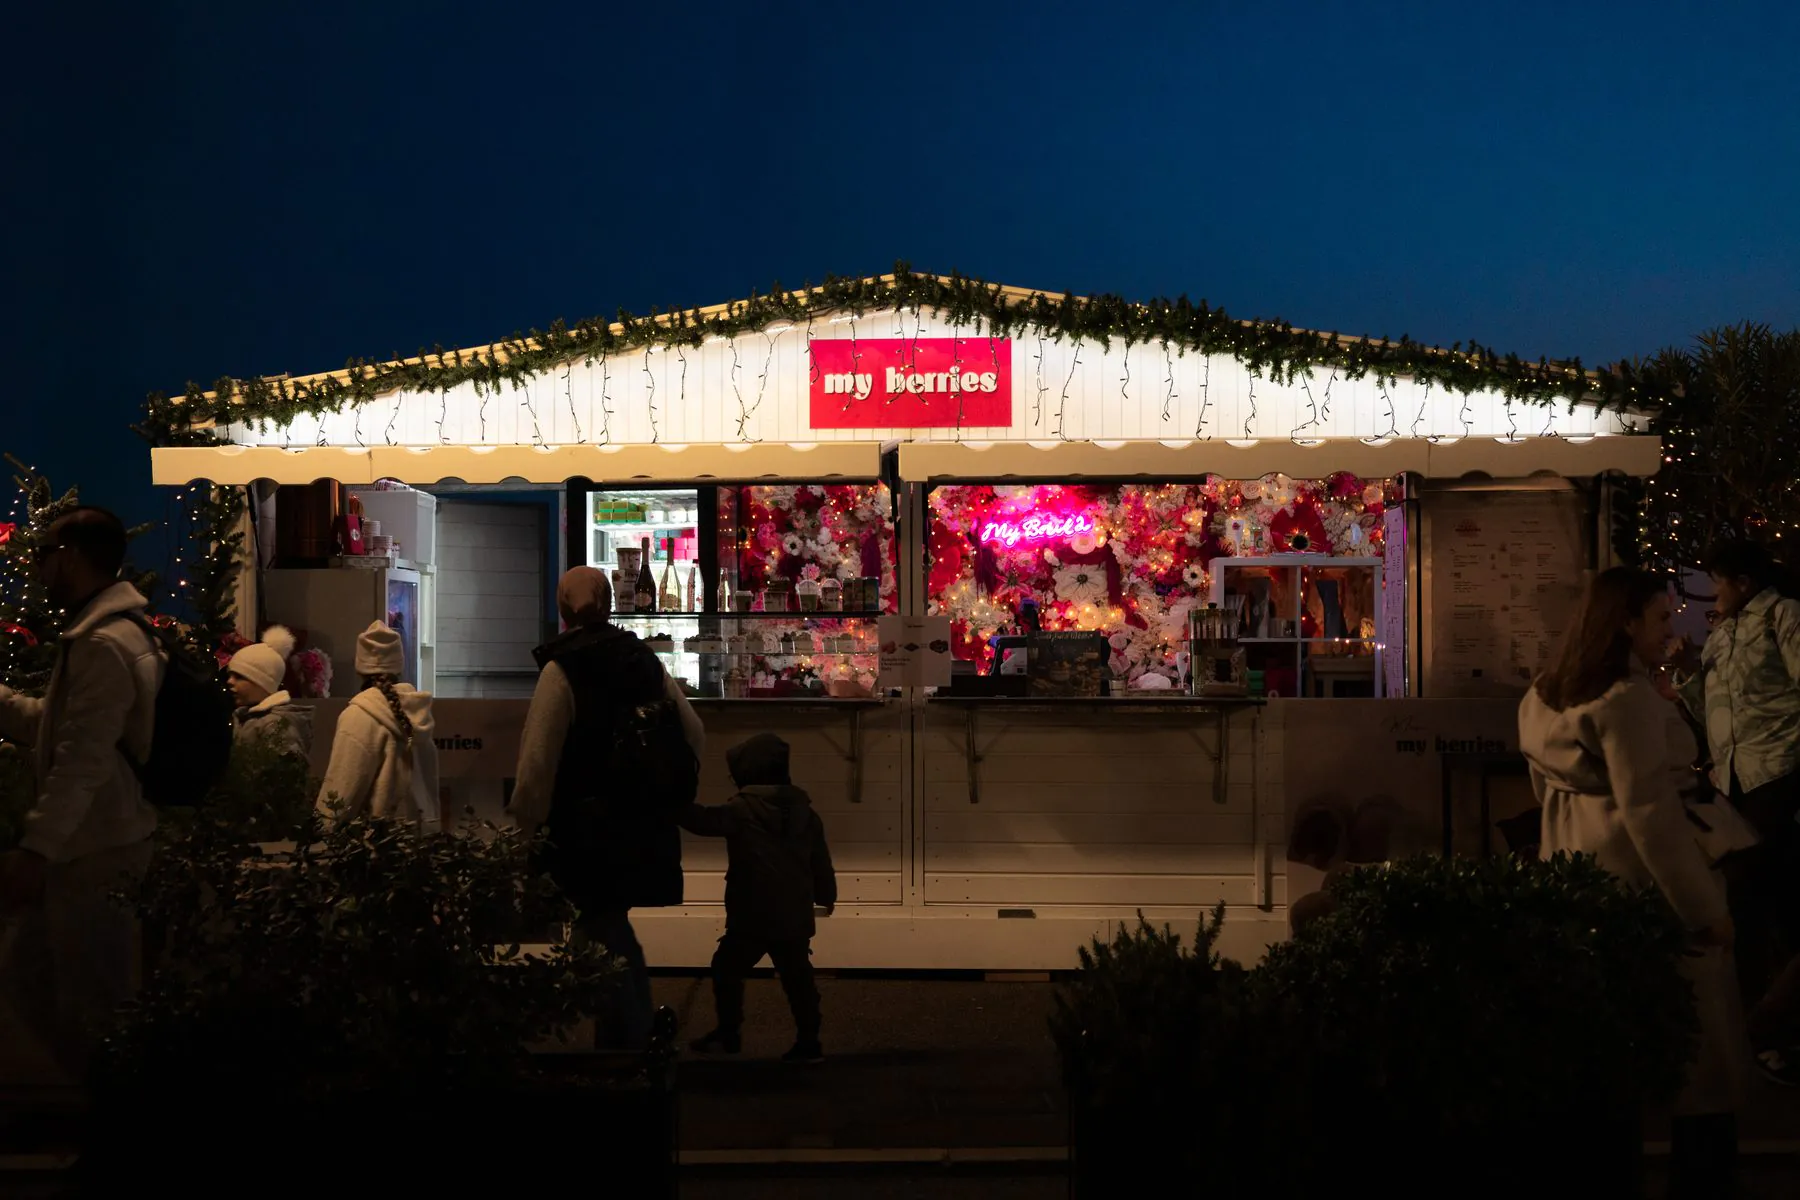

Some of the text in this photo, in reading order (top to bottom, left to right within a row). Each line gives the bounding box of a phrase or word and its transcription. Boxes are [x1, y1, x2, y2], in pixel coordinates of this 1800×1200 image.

[824, 366, 998, 400] my berries
[981, 522, 1021, 546] My
[1396, 735, 1506, 756] my berries
